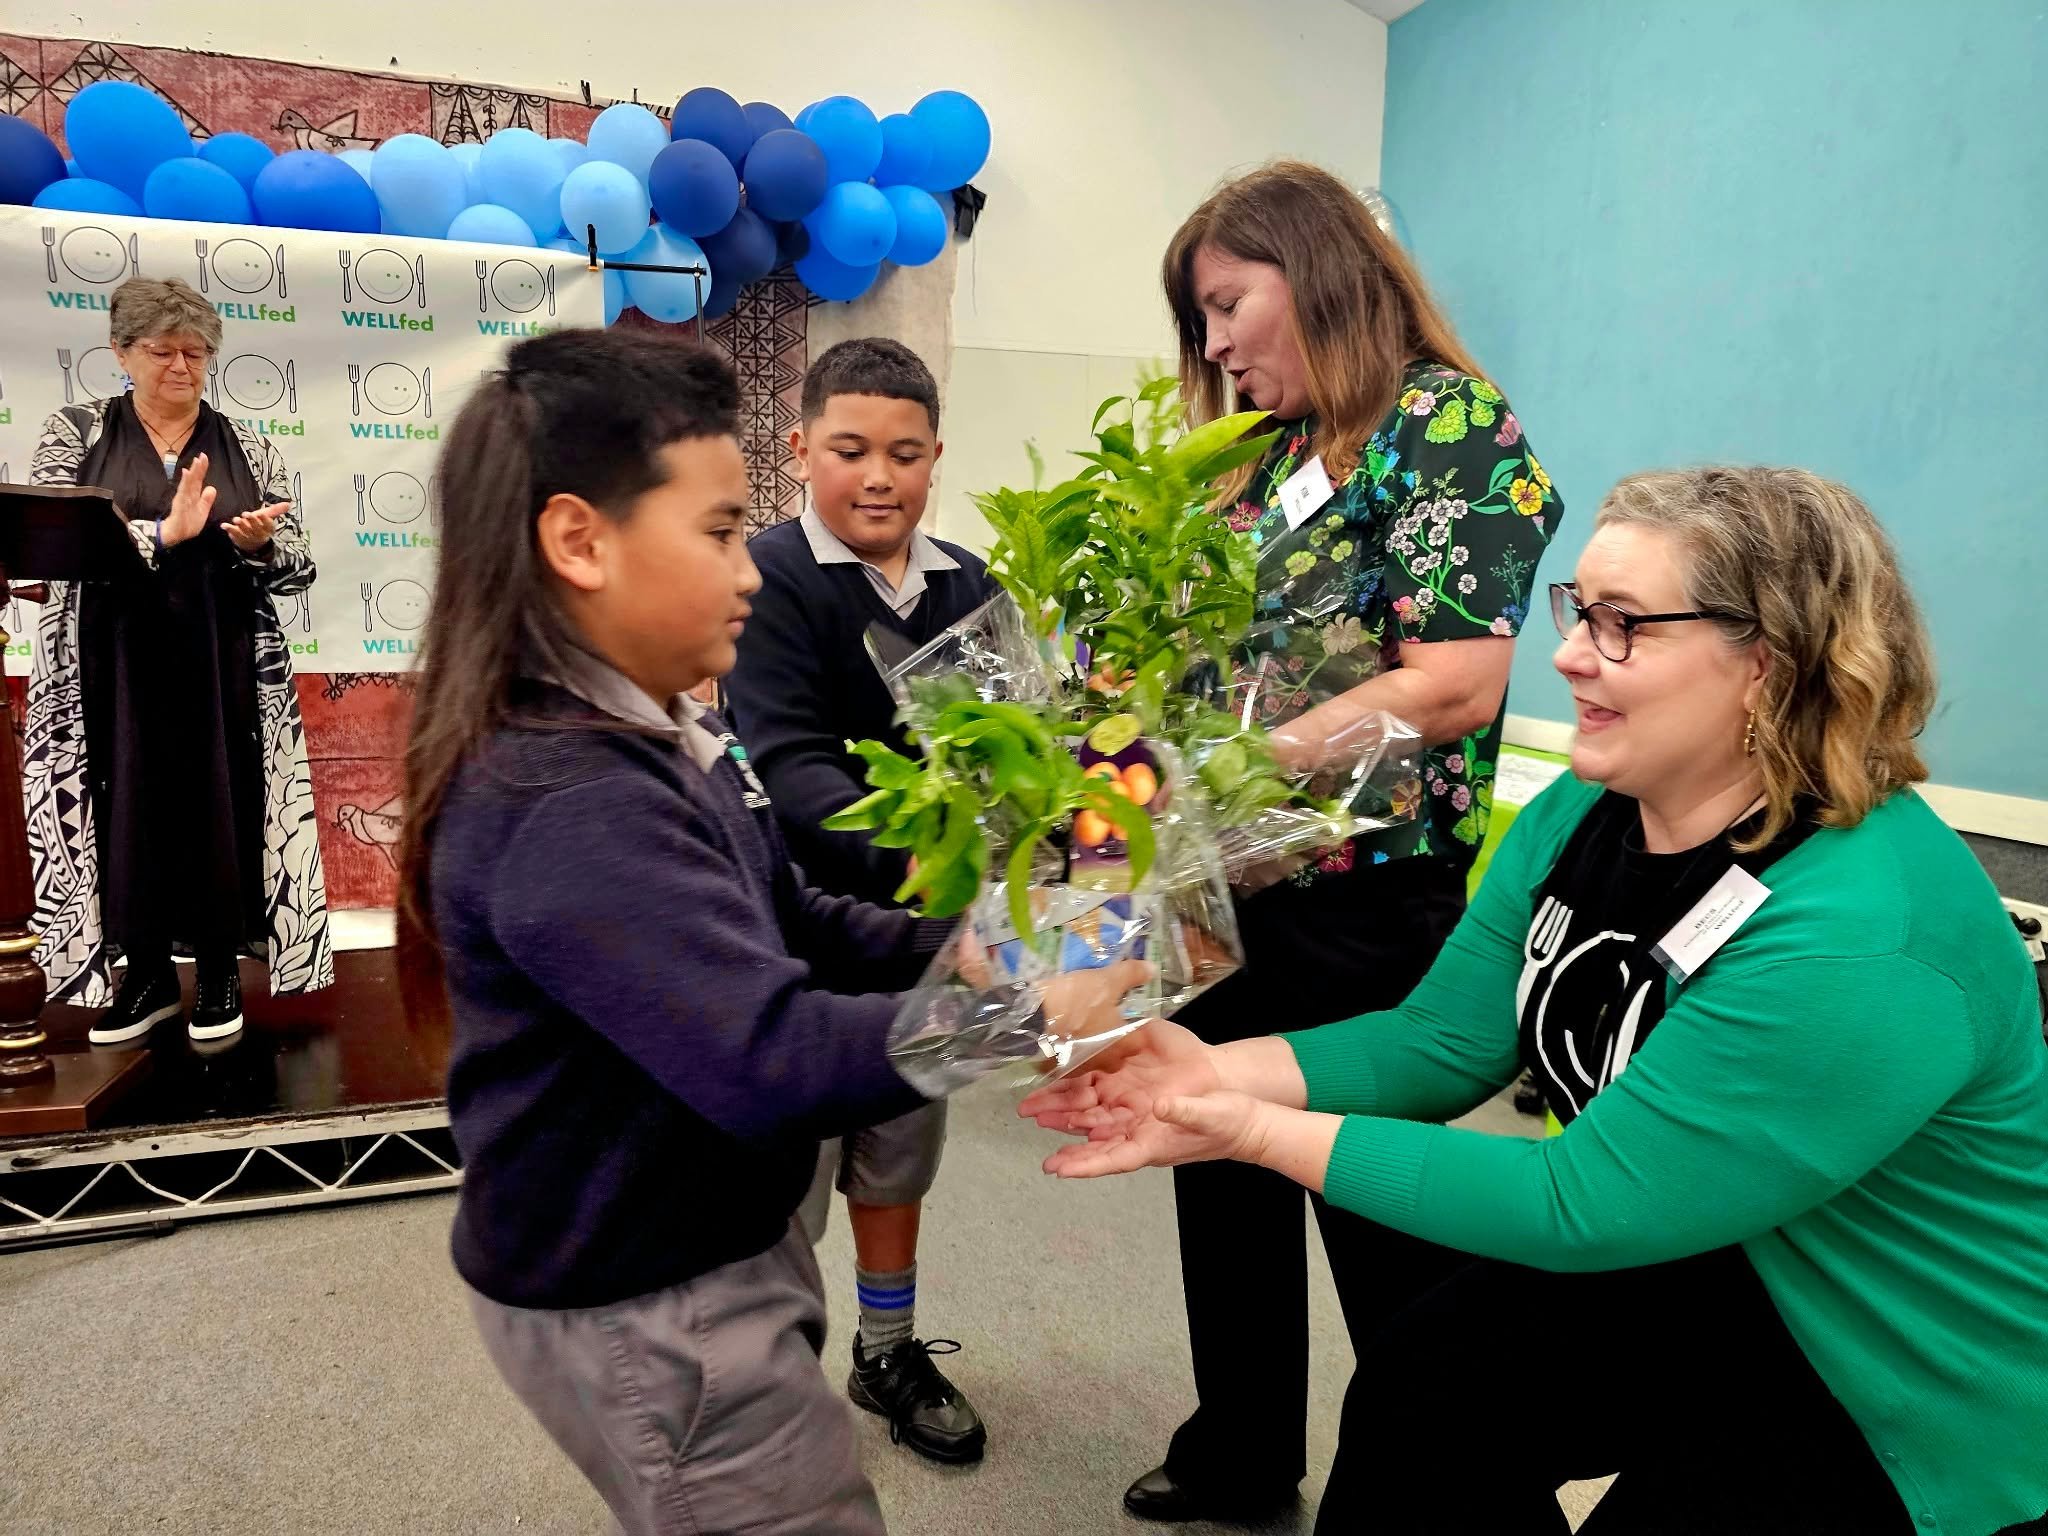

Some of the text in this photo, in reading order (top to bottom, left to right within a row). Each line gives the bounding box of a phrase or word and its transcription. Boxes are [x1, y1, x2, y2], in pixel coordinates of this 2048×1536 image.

[47, 291, 111, 311] WELL
[342, 311, 433, 332] WELLfed
[477, 320, 547, 336] WELLfe
[350, 423, 439, 440] WELLfed
[363, 640, 415, 654] WELL
